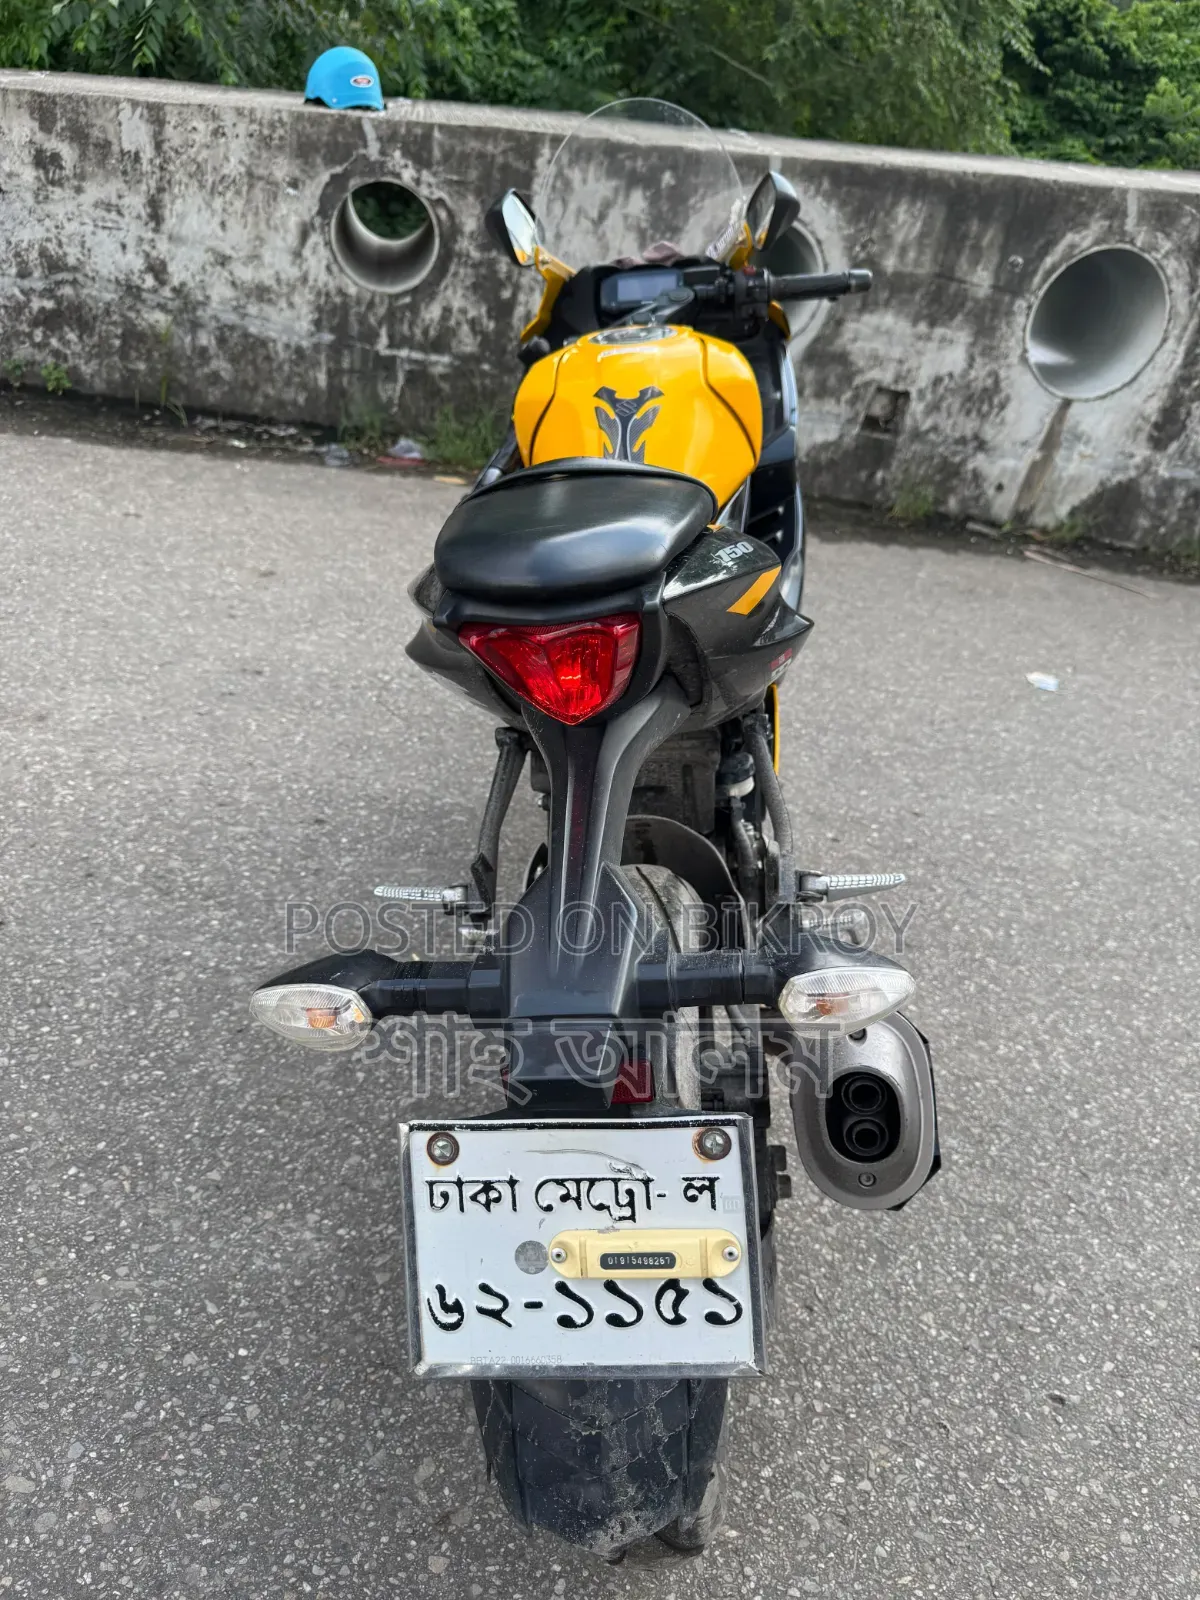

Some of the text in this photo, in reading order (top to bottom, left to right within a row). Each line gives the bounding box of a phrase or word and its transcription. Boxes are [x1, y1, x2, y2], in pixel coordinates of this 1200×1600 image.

[715, 541, 754, 563] 150
[424, 1174, 520, 1213] ঢাকা
[426, 1278, 744, 1332] ৬২-১১৫১
